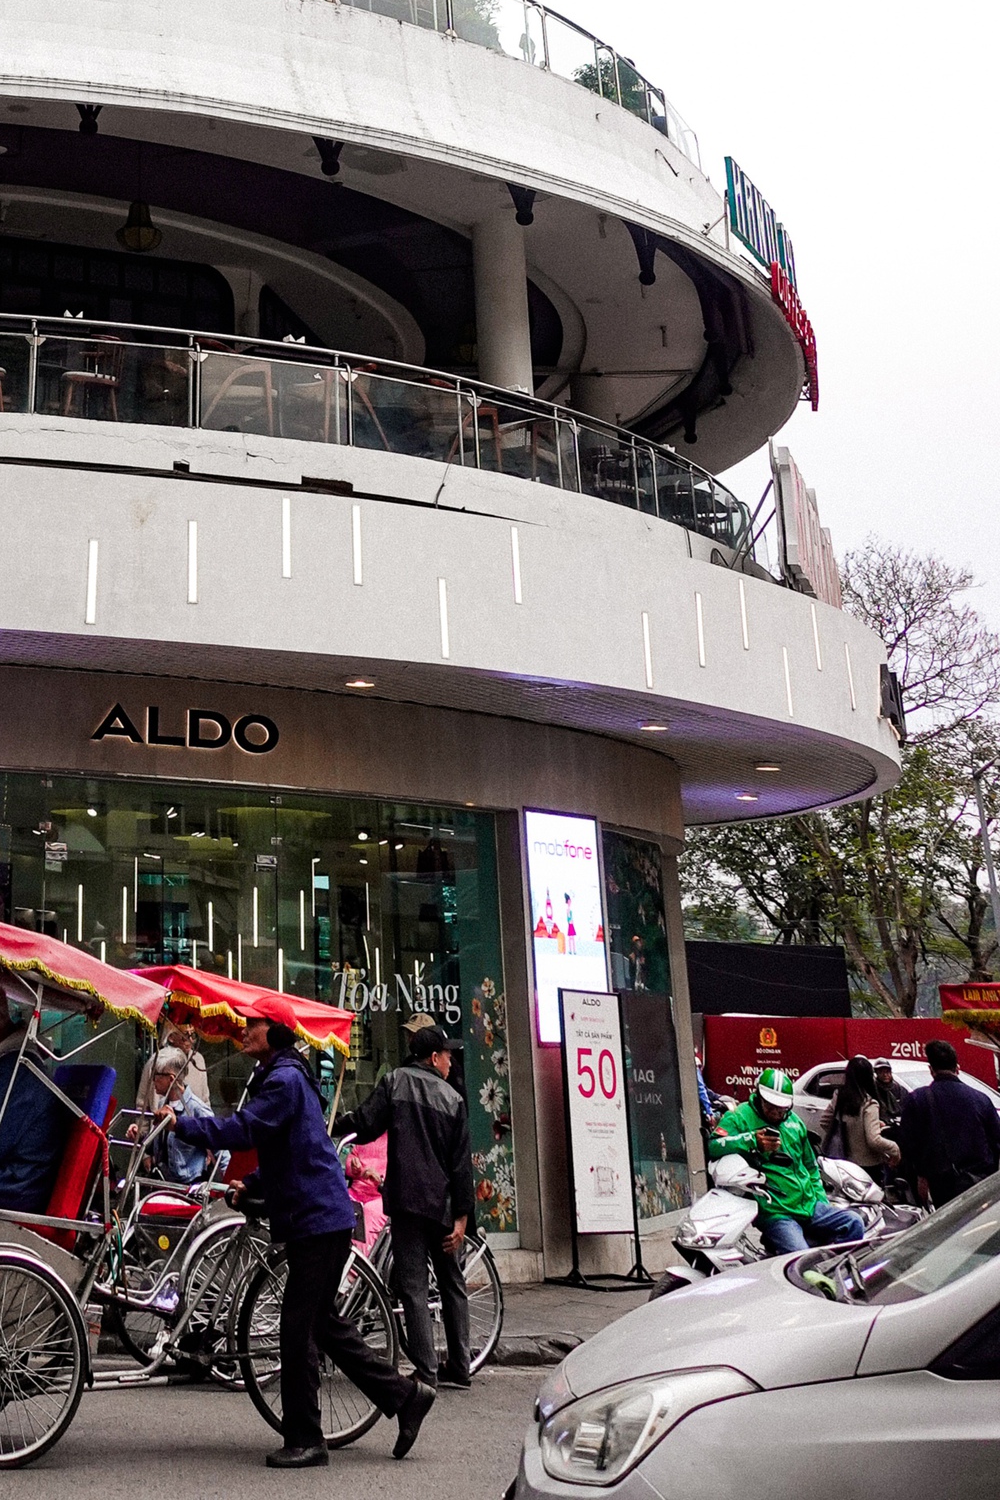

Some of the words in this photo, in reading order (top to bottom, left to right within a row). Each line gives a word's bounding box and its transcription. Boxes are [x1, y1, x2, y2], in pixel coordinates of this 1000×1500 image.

[90, 703, 280, 756] ALDO
[534, 840, 593, 860] mobifone
[582, 999, 601, 1007] ALDO
[577, 1048, 617, 1099] 50
[741, 1066, 763, 1076] VINH
